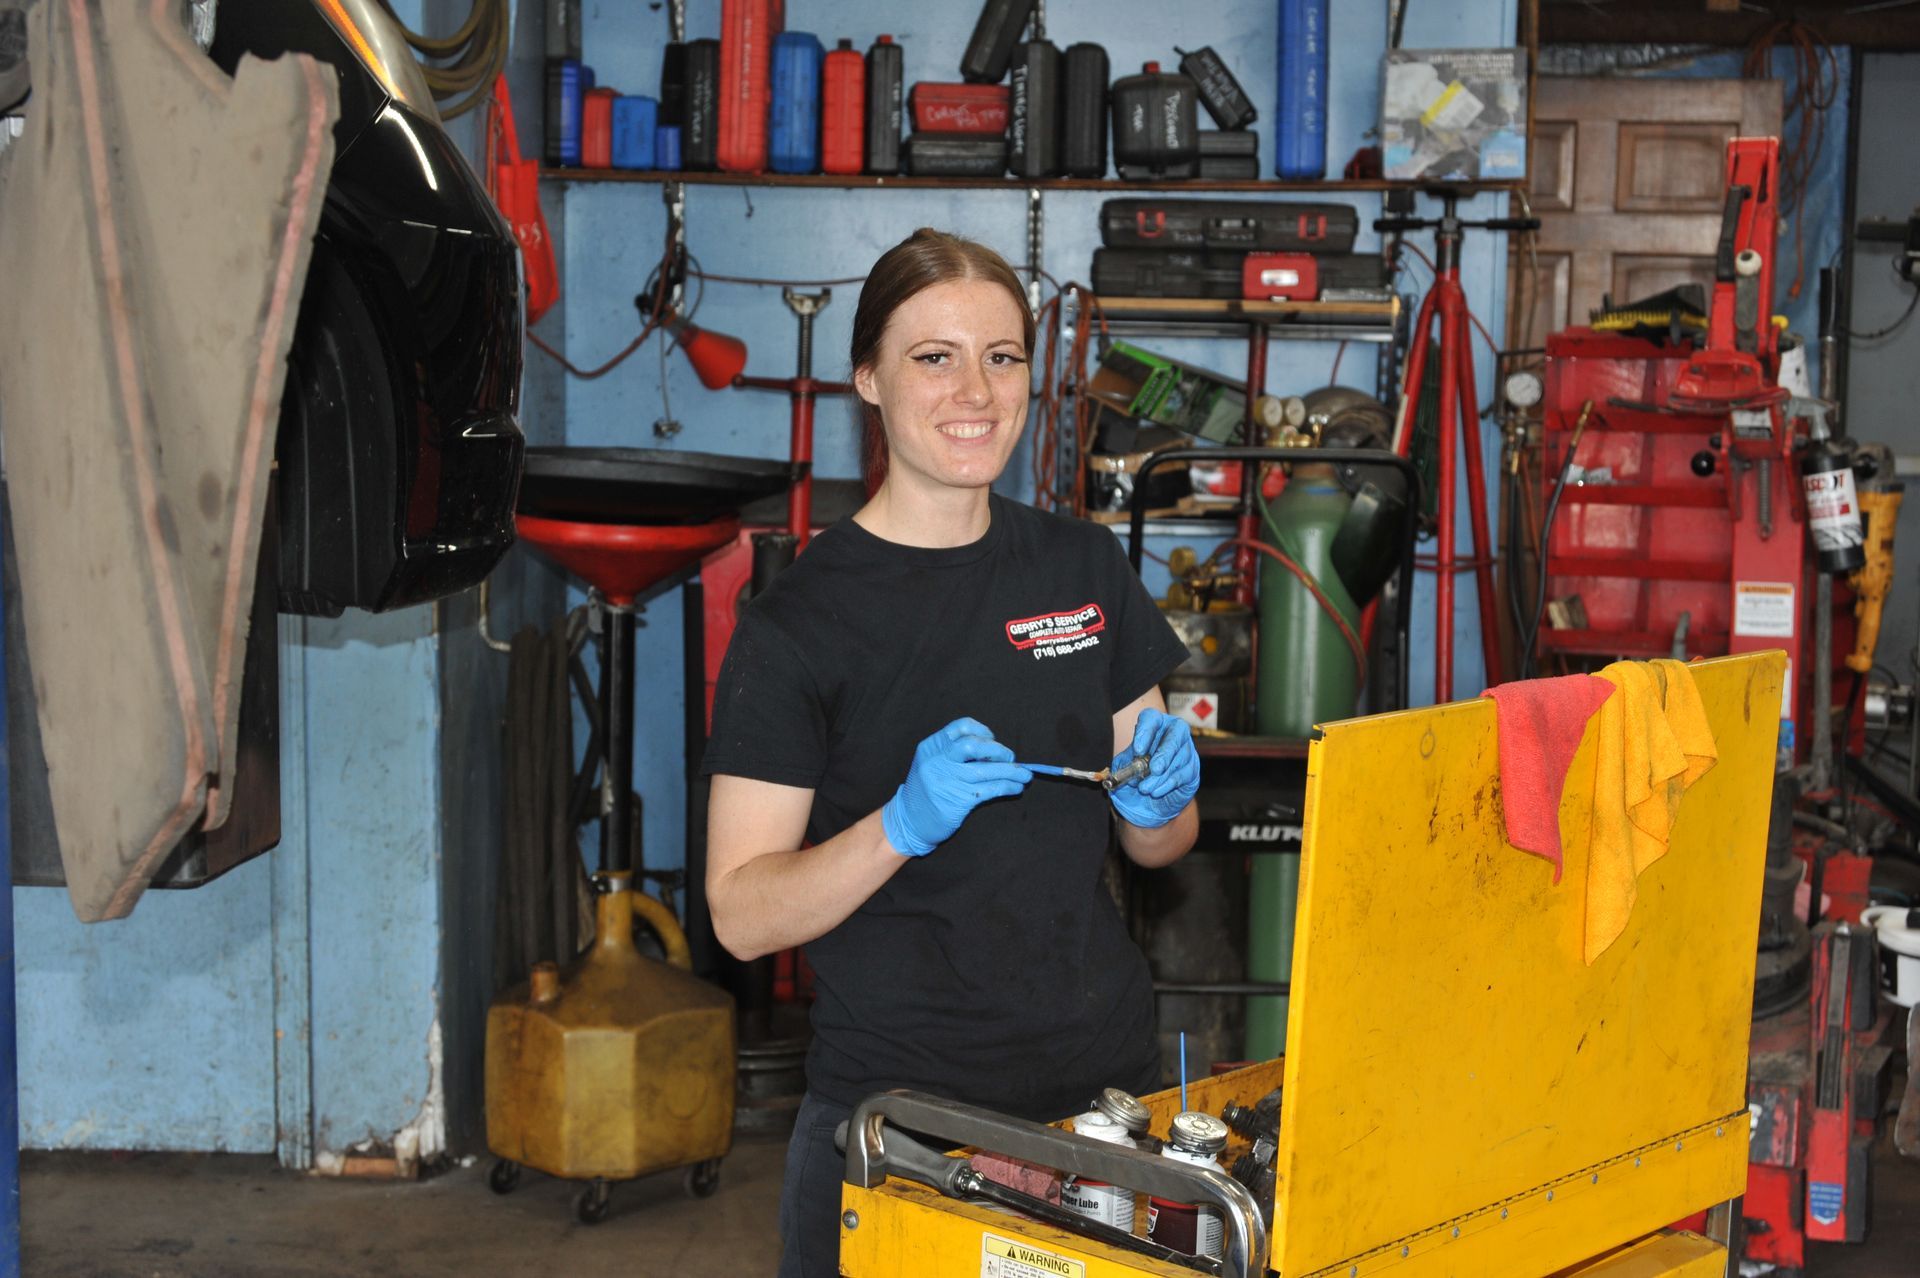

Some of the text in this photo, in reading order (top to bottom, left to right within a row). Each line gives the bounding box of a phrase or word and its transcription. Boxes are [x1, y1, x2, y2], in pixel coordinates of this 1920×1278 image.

[1009, 607, 1097, 635] GERRY'S SERVICE
[1033, 636, 1100, 660] (716) 688-0402
[1078, 1197, 1099, 1209] Lube
[1019, 1249, 1070, 1274] WARNING
